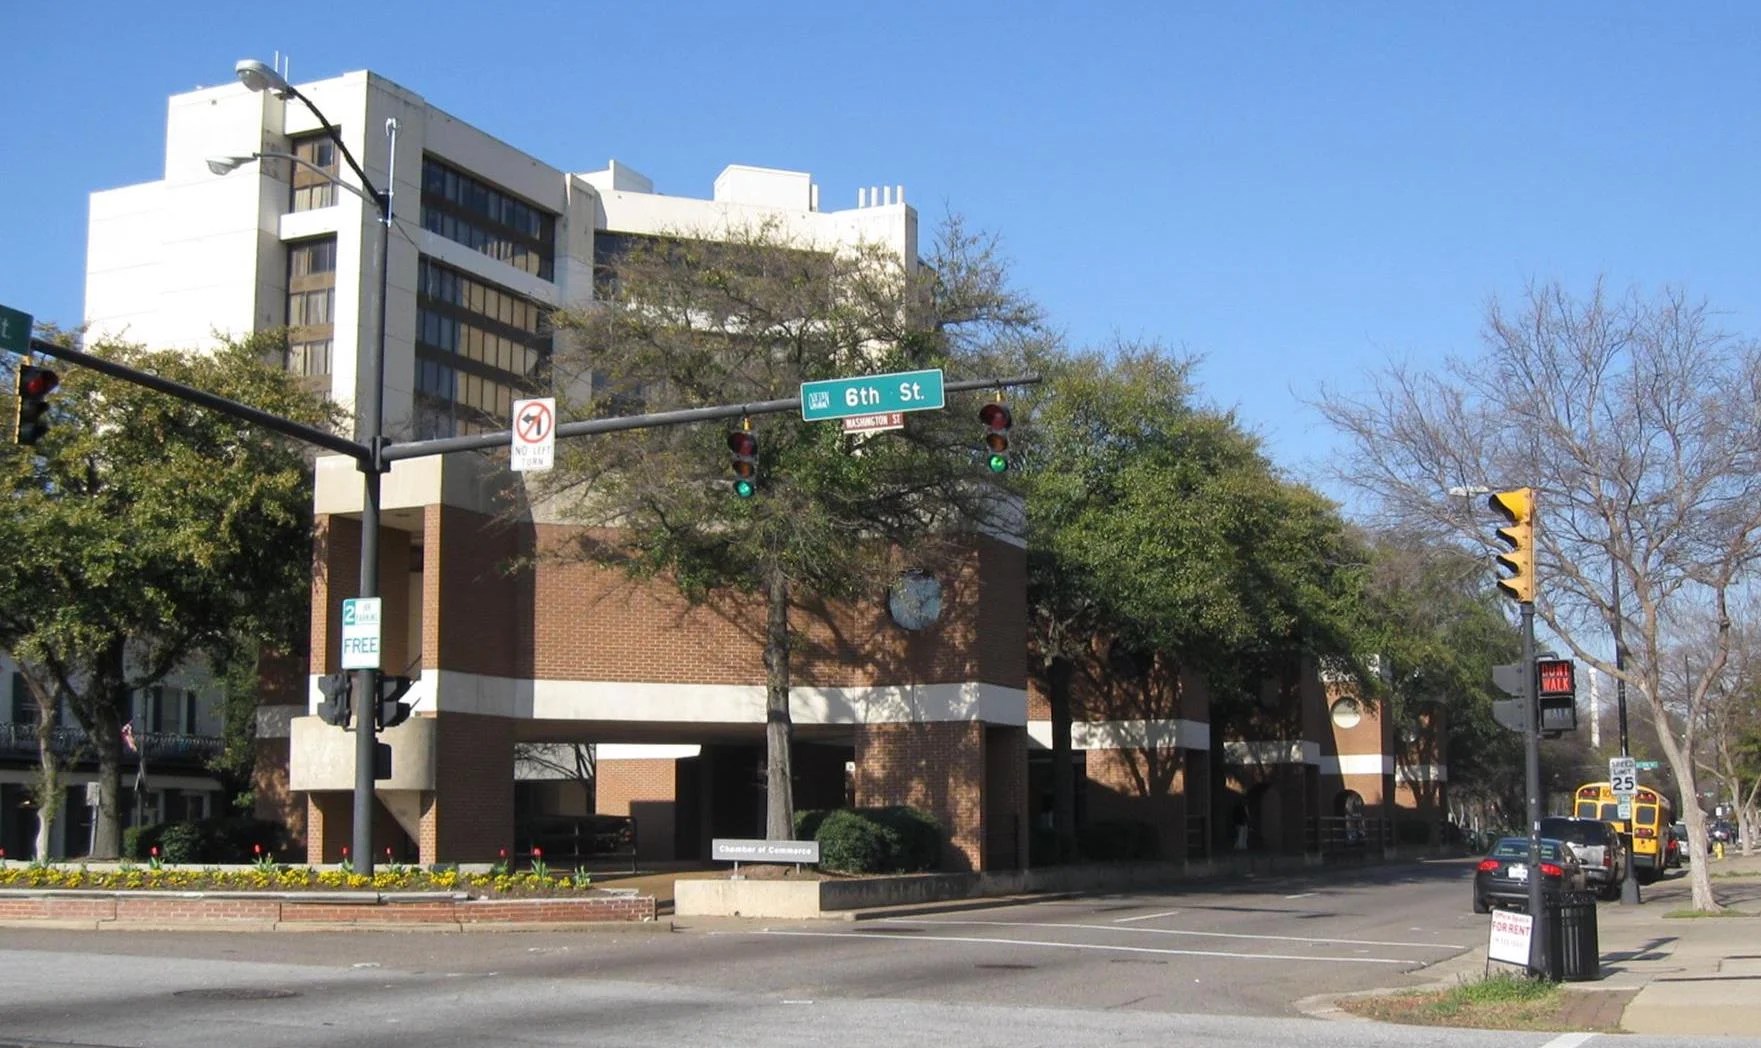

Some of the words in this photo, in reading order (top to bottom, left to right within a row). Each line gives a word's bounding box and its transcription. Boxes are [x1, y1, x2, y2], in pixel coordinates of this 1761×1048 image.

[845, 386, 880, 407] 6th
[899, 381, 925, 401] St.
[846, 414, 888, 428] WASHINGTON
[515, 445, 528, 456] NO
[533, 445, 551, 456] LEFT
[522, 456, 544, 466] TURN
[344, 604, 355, 623] 2
[344, 636, 379, 654] FREE
[1542, 677, 1570, 692] WALK
[1612, 768, 1632, 776] LIMIT
[1613, 776, 1634, 791] 25
[719, 844, 756, 853] Chamber
[758, 845, 767, 854] of
[768, 846, 812, 856] Commerce
[1492, 921, 1507, 933] FOR
[1508, 923, 1531, 937] RENT
